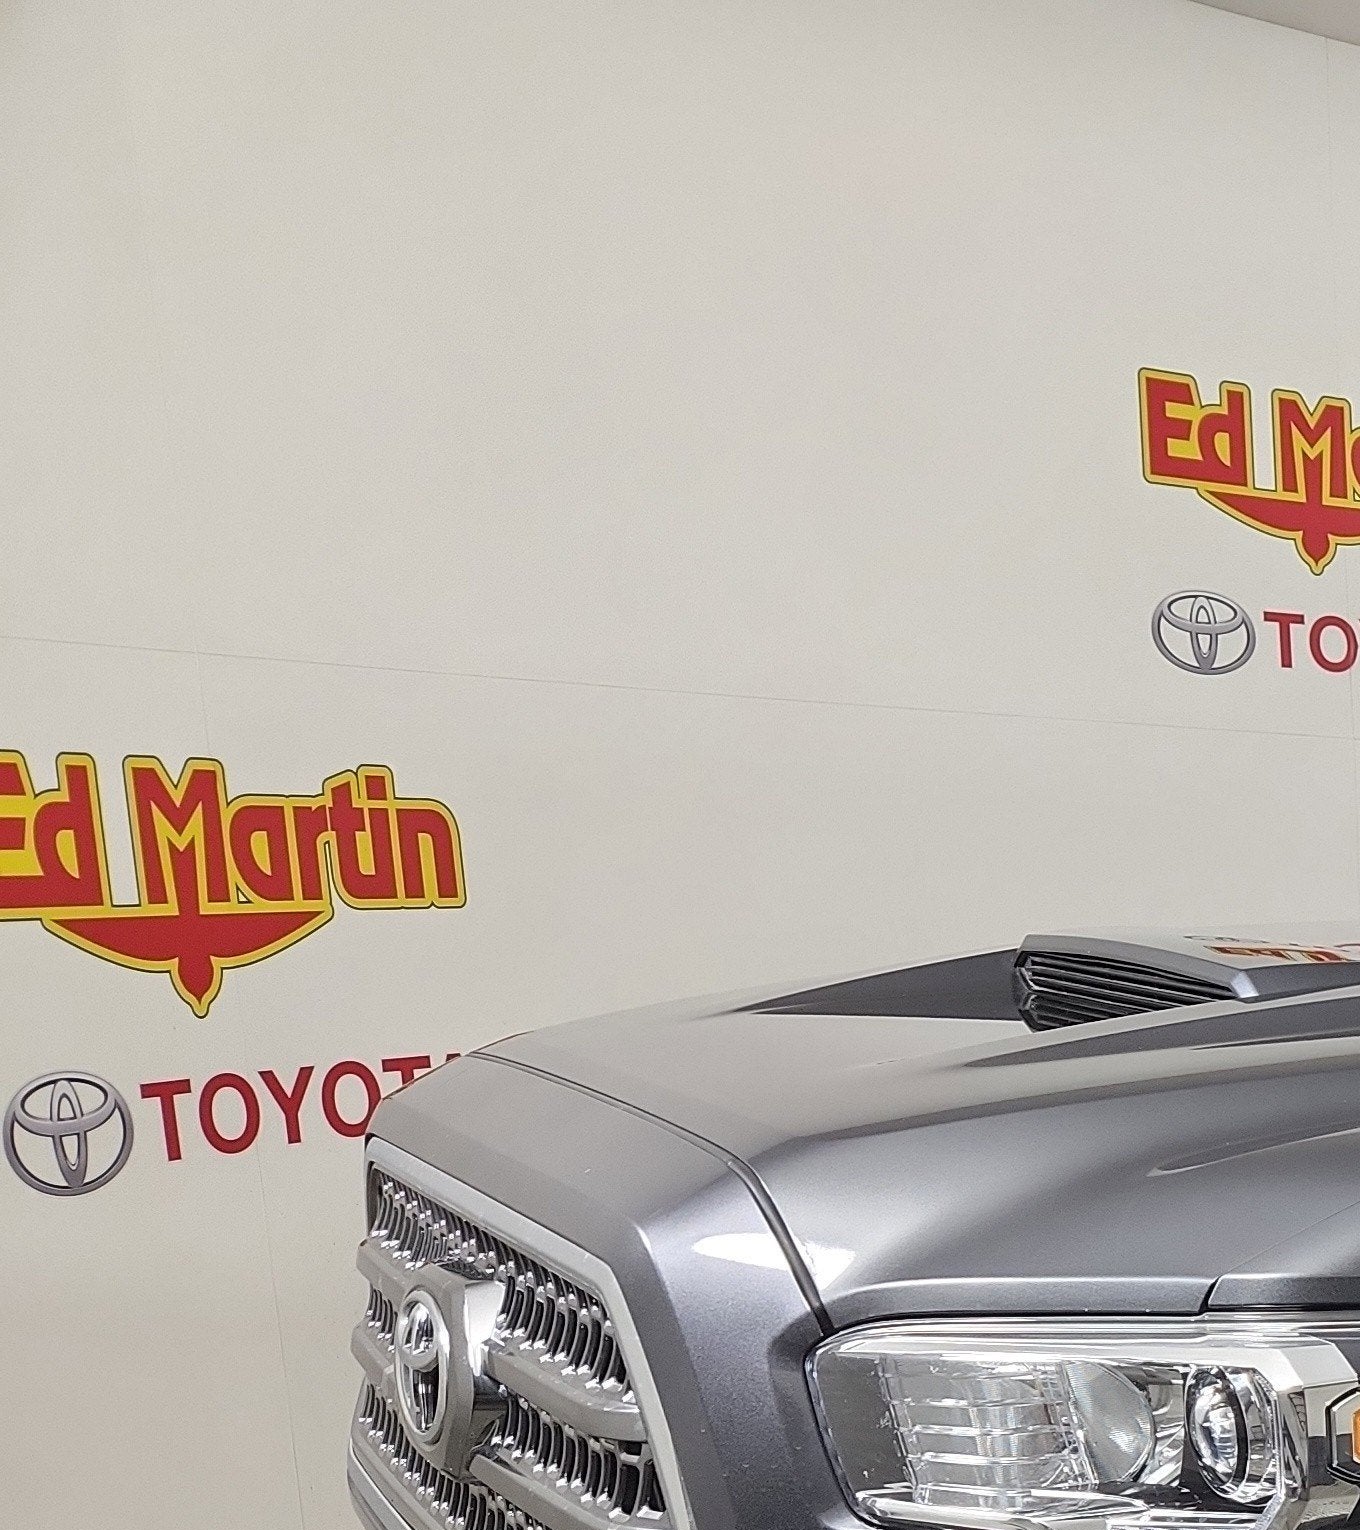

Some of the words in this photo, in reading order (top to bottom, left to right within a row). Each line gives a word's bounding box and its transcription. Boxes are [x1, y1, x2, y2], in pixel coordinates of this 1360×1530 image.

[1141, 371, 1250, 489] Ed
[126, 758, 464, 908] Martin
[139, 1053, 463, 1162] TOYO
